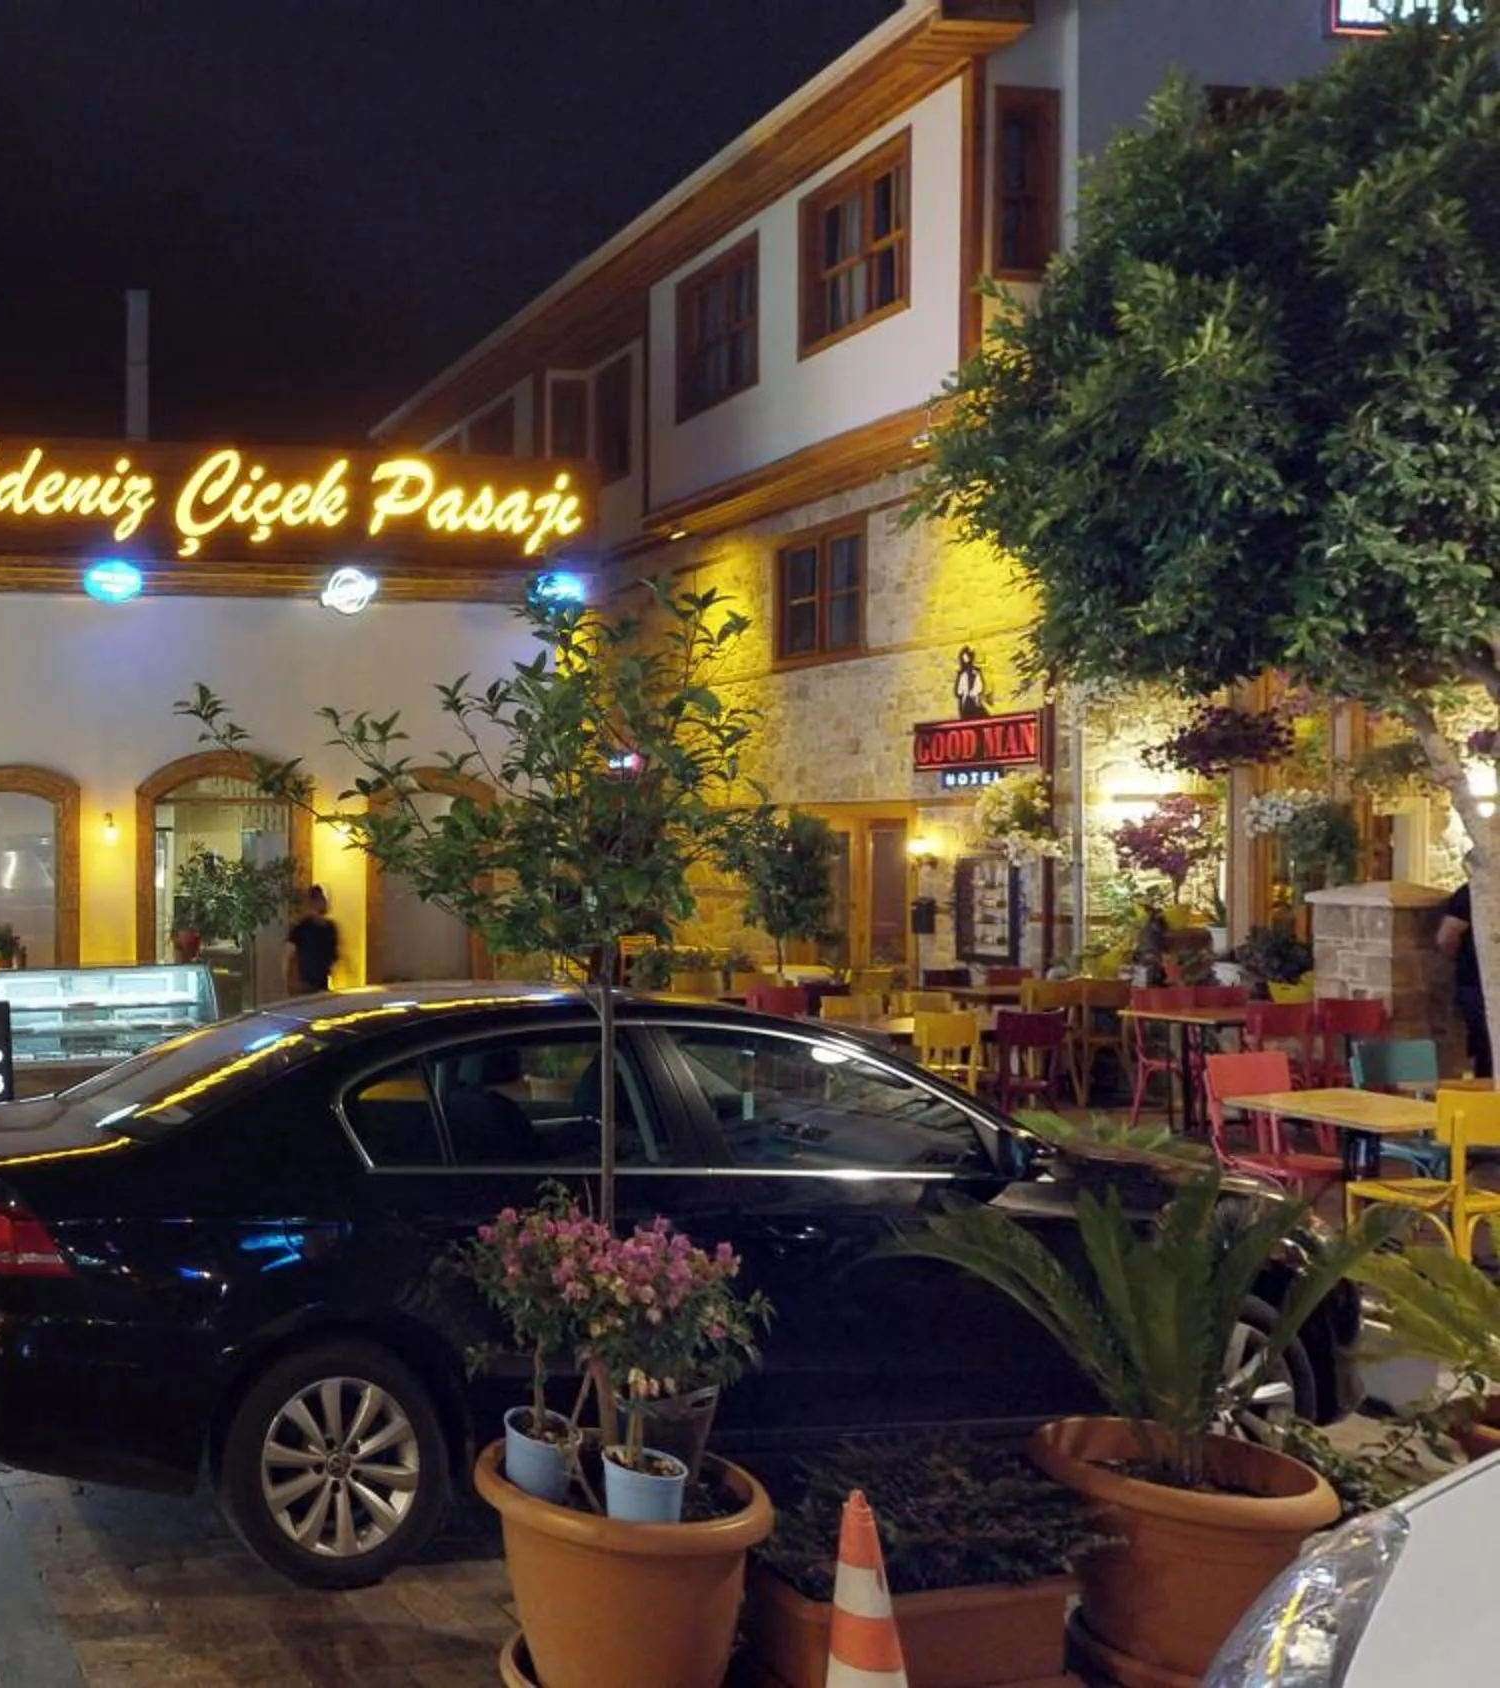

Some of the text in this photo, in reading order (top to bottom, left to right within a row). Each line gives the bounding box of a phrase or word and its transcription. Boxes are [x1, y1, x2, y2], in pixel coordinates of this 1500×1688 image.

[175, 449, 350, 557] Çiçek
[916, 720, 1038, 764] GOOD MAN
